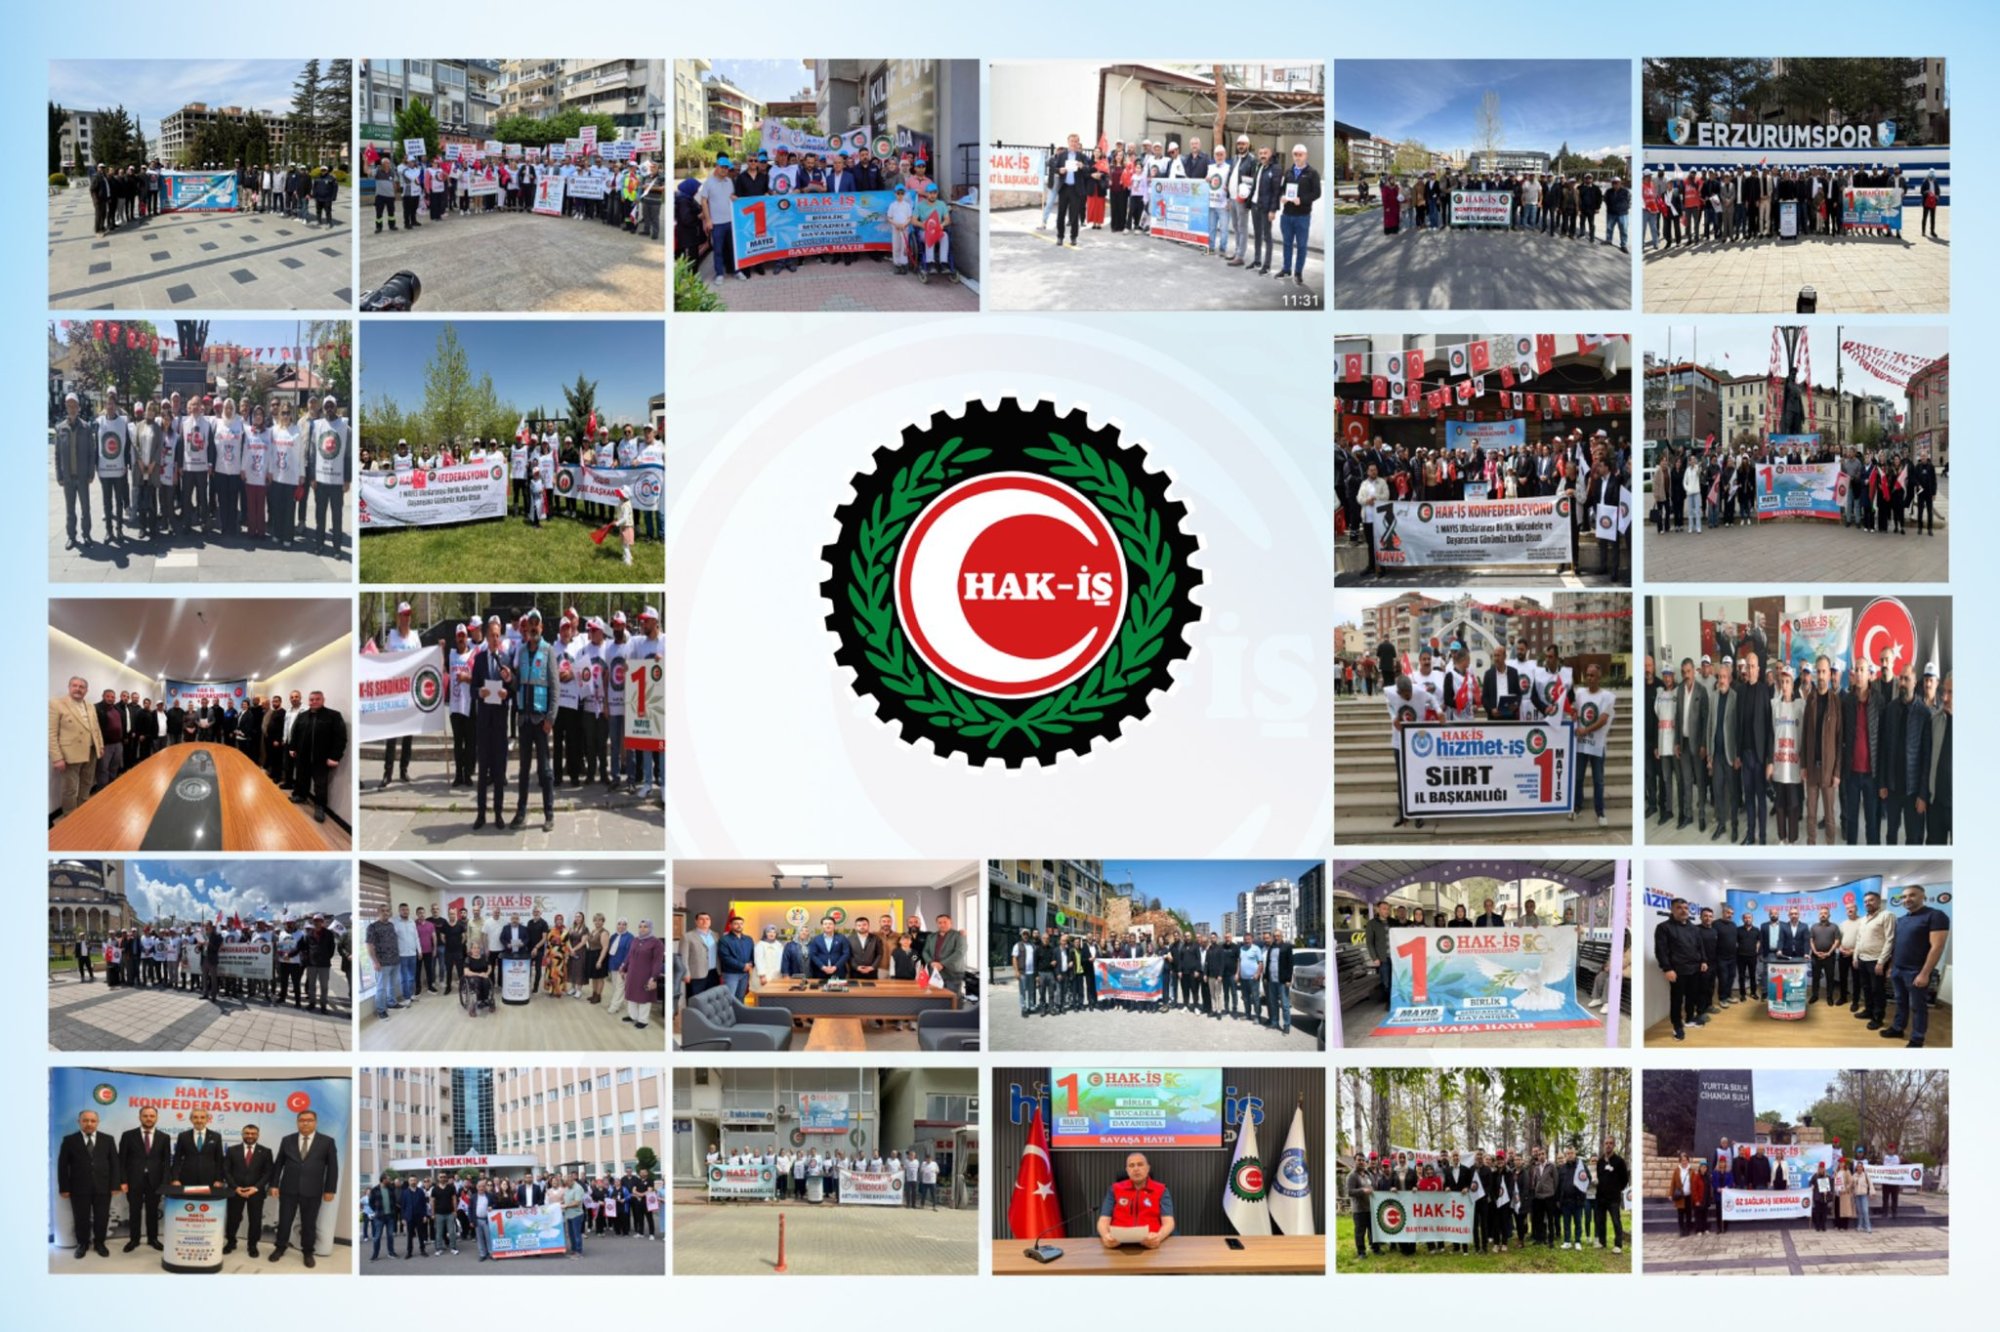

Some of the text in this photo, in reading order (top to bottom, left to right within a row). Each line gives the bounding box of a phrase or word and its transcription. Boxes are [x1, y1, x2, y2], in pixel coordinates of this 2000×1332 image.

[1697, 122, 1872, 148] ERZURUMSPOR
[1845, 190, 1855, 211] 1
[742, 200, 767, 238] 1
[749, 237, 774, 249] MAYIS
[1760, 466, 1773, 494] 1
[1468, 503, 1553, 518] KONFEDERASYONU
[1781, 619, 1792, 661] 1
[631, 666, 646, 718] 1
[1436, 737, 1526, 758] hizmet-iş
[1534, 748, 1554, 803] 1
[1555, 748, 1565, 802] MAYIS
[1429, 788, 1508, 806] BAŞKANLIĞI
[1456, 931, 1521, 950] HAK-İŞ
[1396, 936, 1428, 1003] 1
[1770, 975, 1783, 1002] 1
[1470, 998, 1501, 1007] BİRLİK
[1400, 1008, 1439, 1017] MAYIS
[1415, 1022, 1536, 1034] SAVAŞA HAYIR
[1056, 1073, 1079, 1116] 1
[1702, 1081, 1749, 1092] YURTTA SULH
[128, 1096, 277, 1114] KONFEDERASYONU
[1122, 1098, 1152, 1107] BİRLİK
[1732, 1093, 1750, 1101] SULH
[1113, 1109, 1161, 1117] MÜCADELE
[1112, 1119, 1163, 1128] DAYANIŞMA
[1100, 1136, 1176, 1145] SAVAŞA HAYIR
[426, 1156, 488, 1167] BAŞHEKİMLİK
[1413, 1200, 1465, 1221] HAK-İŞ
[490, 1212, 504, 1238] 1
